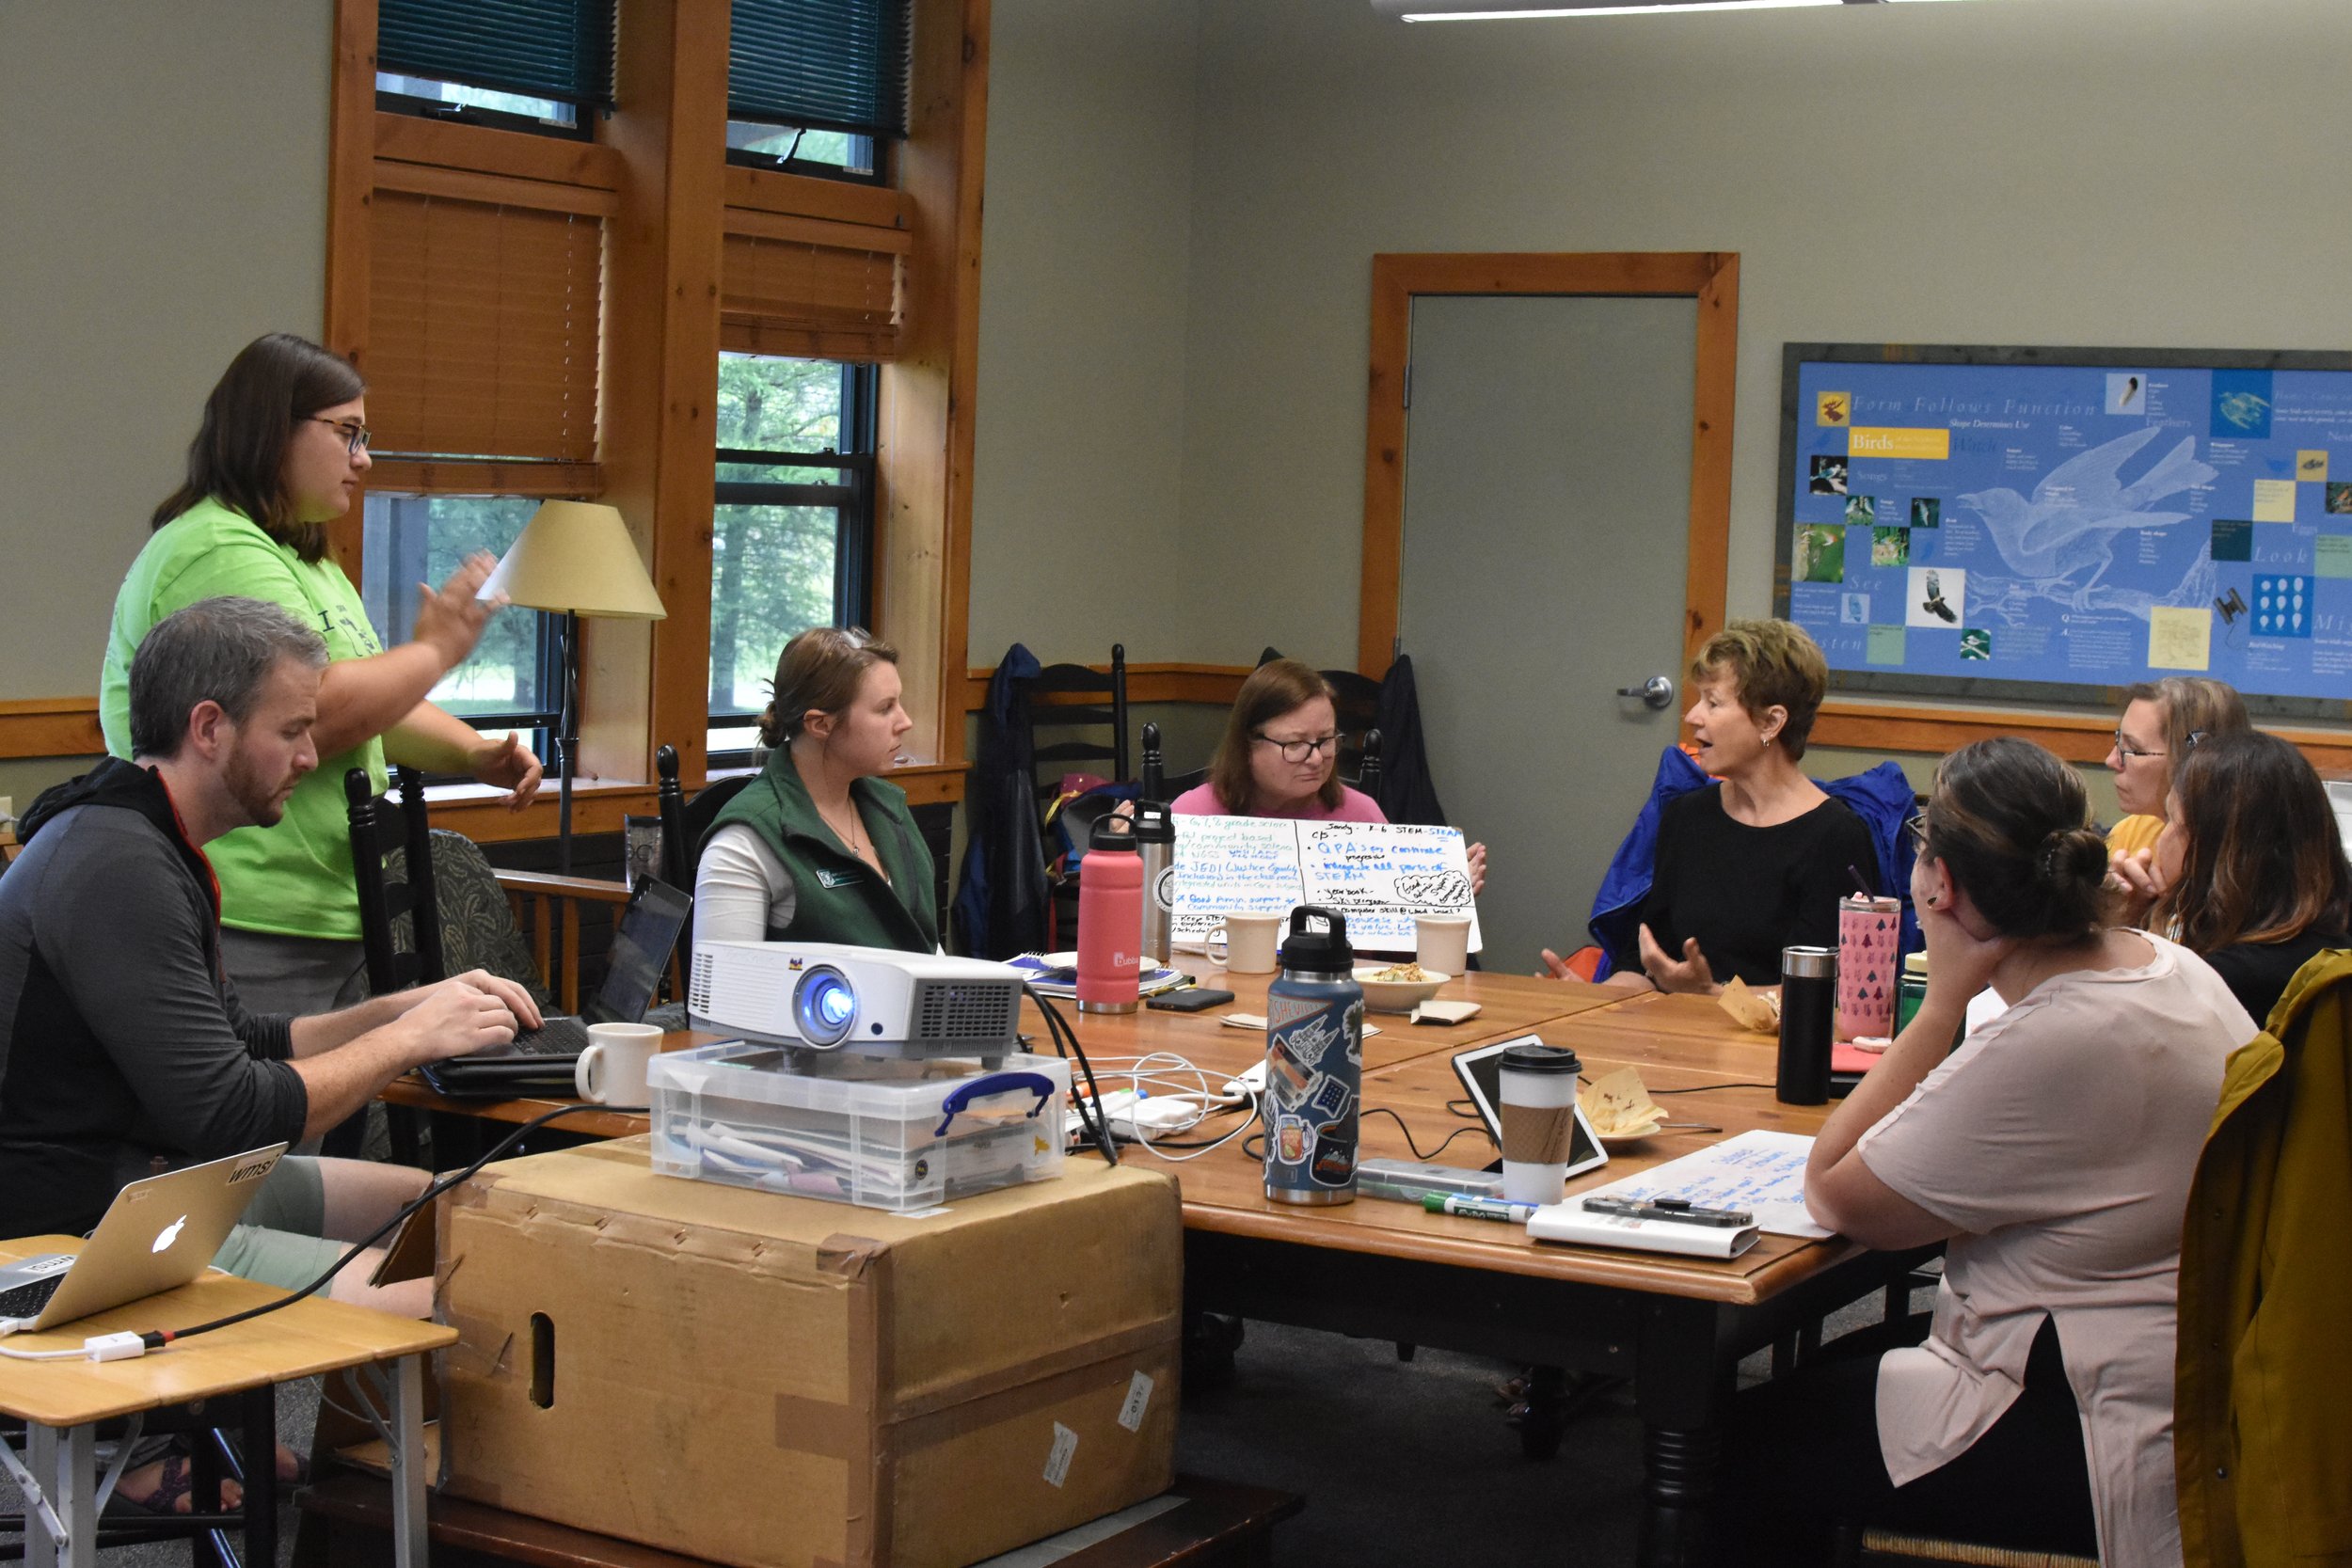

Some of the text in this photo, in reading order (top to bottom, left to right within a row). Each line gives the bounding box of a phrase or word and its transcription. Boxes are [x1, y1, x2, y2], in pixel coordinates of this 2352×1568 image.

[1852, 396, 2098, 416] Form Follows Function
[1949, 419, 1972, 429] Shape
[1852, 434, 1894, 451] Birds
[2253, 546, 2308, 564] Look
[1849, 576, 1882, 590] See
[1325, 824, 1354, 834] Sandy
[229, 1153, 281, 1183] wmsi
